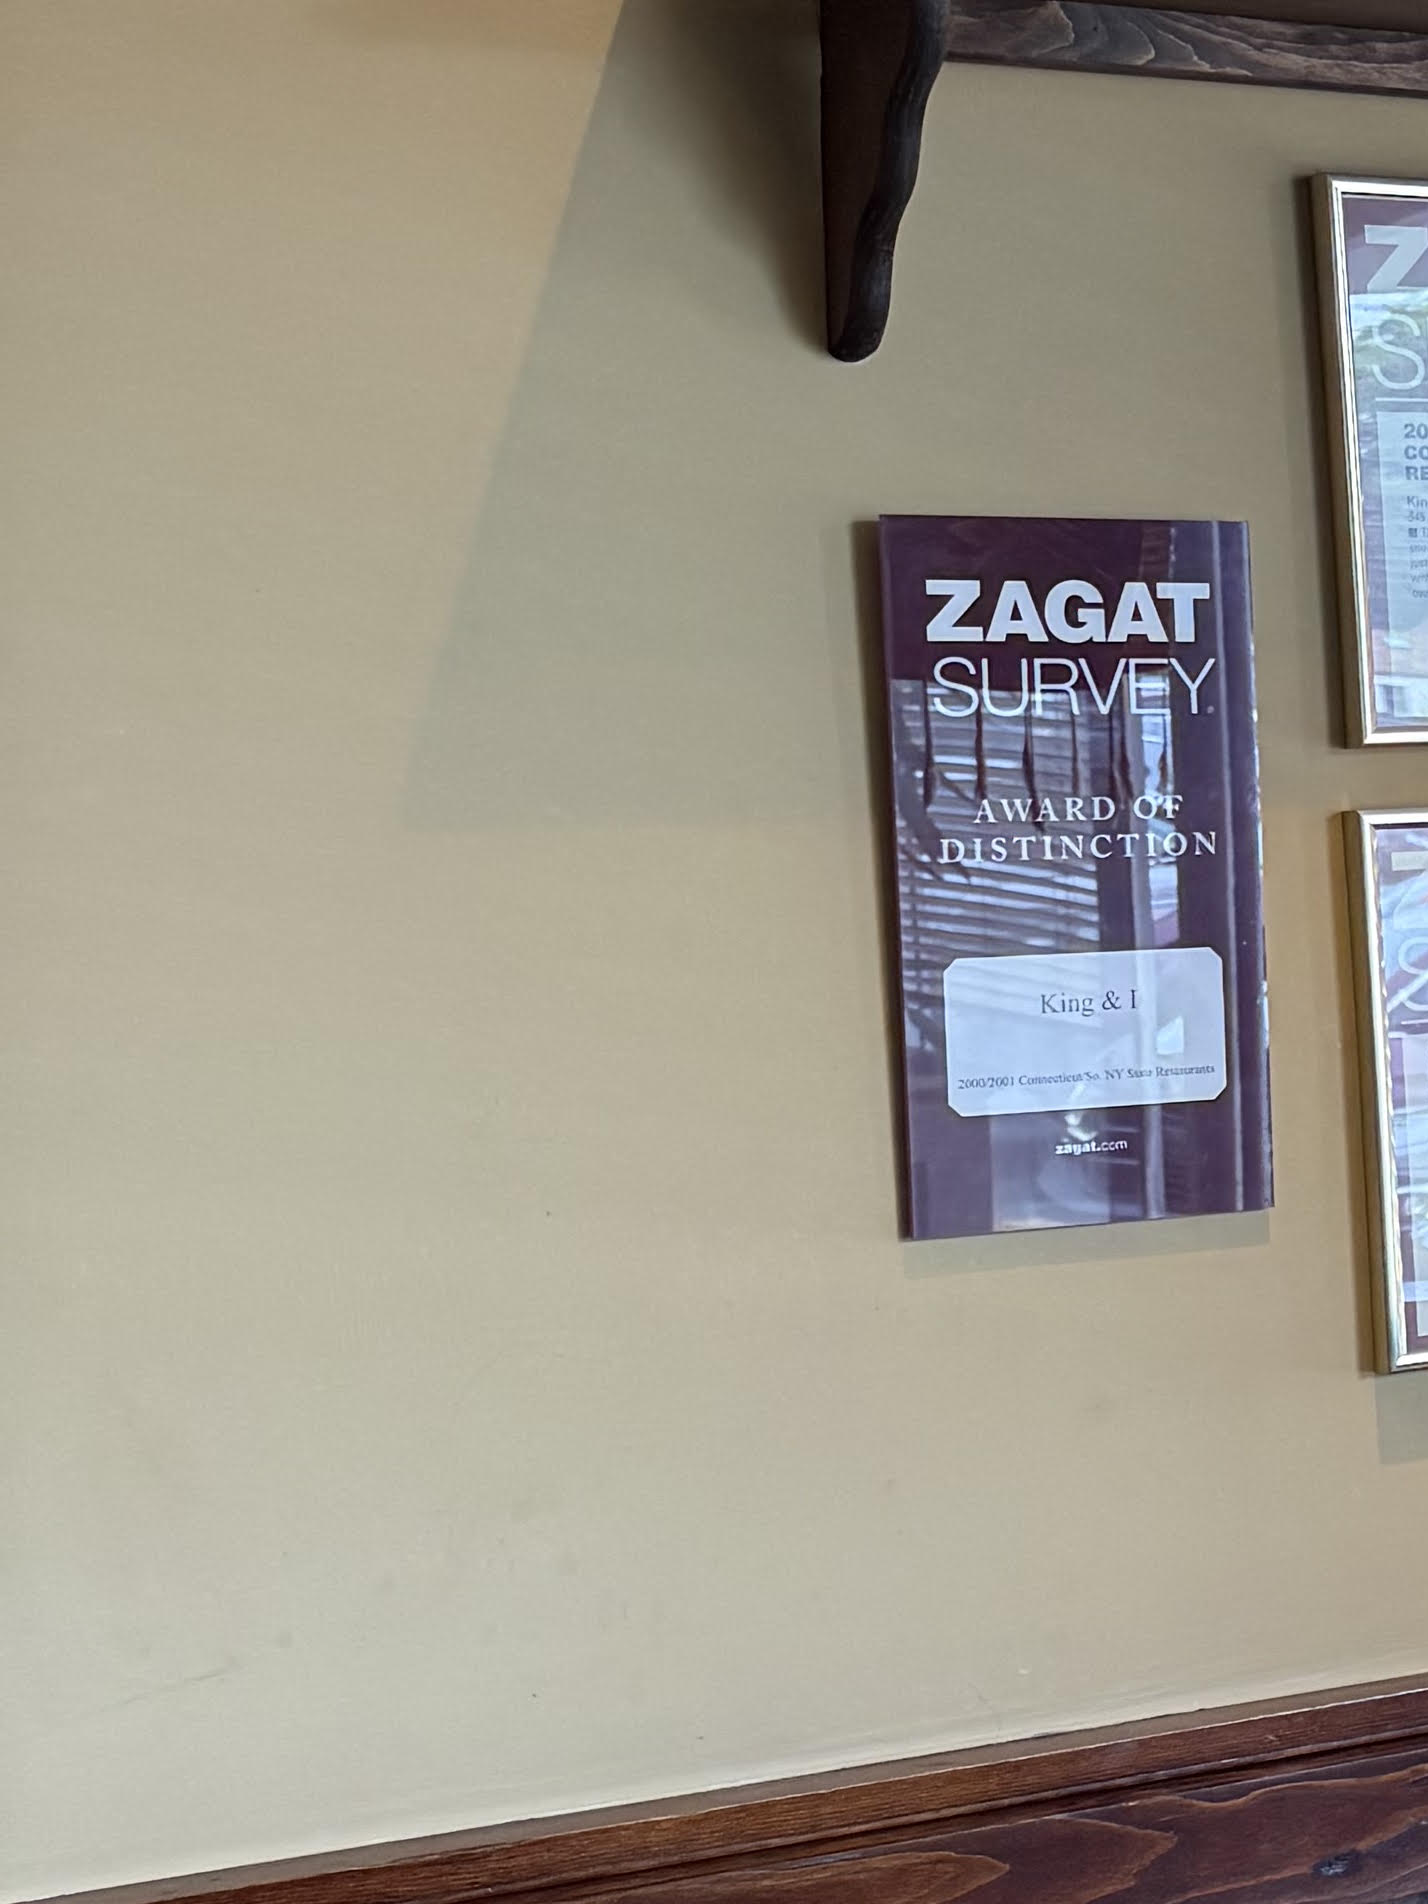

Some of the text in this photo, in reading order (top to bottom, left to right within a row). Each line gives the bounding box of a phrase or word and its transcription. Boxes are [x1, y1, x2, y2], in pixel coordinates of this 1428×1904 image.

[925, 579, 1210, 643] ZAGAT
[933, 656, 1216, 717] SURVEY
[973, 794, 1184, 824] AWARD OF
[938, 831, 1217, 864] DISTINCTION
[1041, 989, 1137, 1017] King & I
[1105, 1068, 1125, 1081] NY
